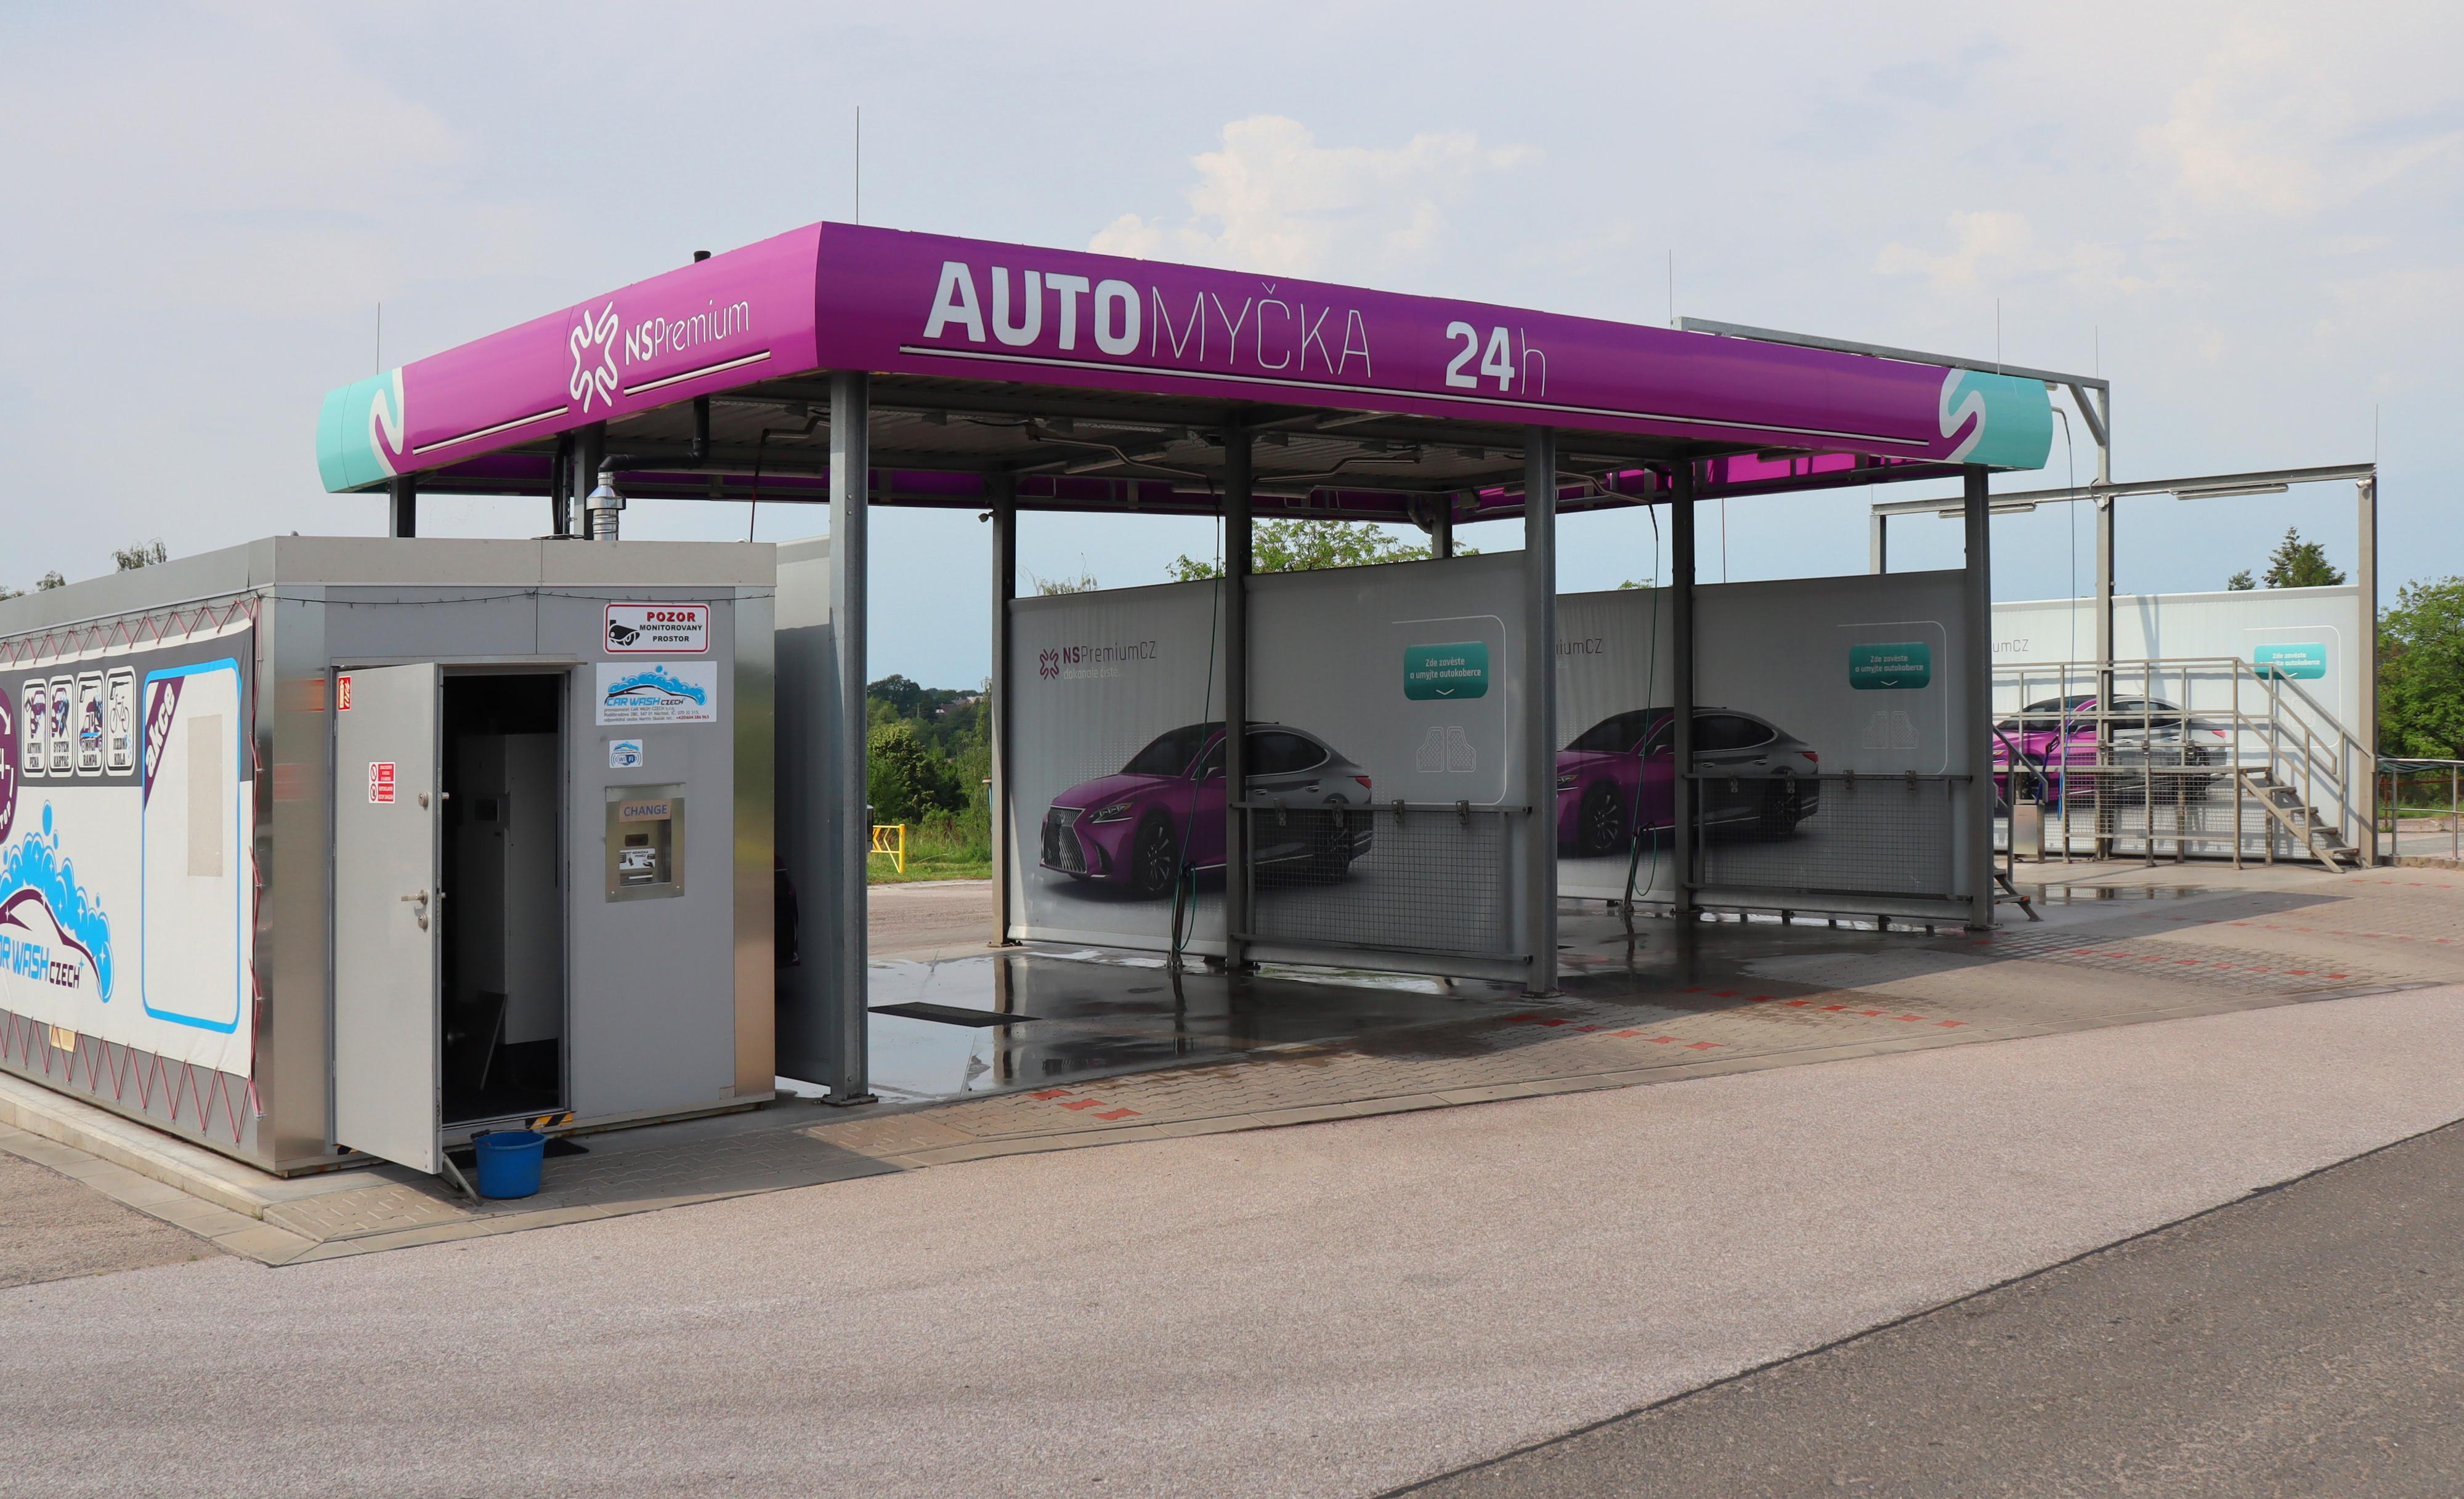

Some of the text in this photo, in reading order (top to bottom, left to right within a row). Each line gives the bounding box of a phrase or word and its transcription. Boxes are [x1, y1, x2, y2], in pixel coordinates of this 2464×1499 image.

[922, 261, 1372, 378] AUTOMYČKA
[625, 299, 749, 366] NSPremium
[1445, 321, 1546, 397] 24h
[647, 612, 696, 622] POZOR
[1063, 641, 1156, 664] NSPremiumCZ
[1425, 658, 1437, 667] Zde
[1416, 669, 1438, 680] umyjte
[1440, 668, 1481, 677] autokoberce
[606, 697, 628, 706] CAR
[630, 697, 661, 706] WASH
[145, 682, 175, 778] akce
[624, 804, 668, 817] CHANGE
[12, 940, 49, 982] WASH
[50, 961, 80, 990] CZECH
